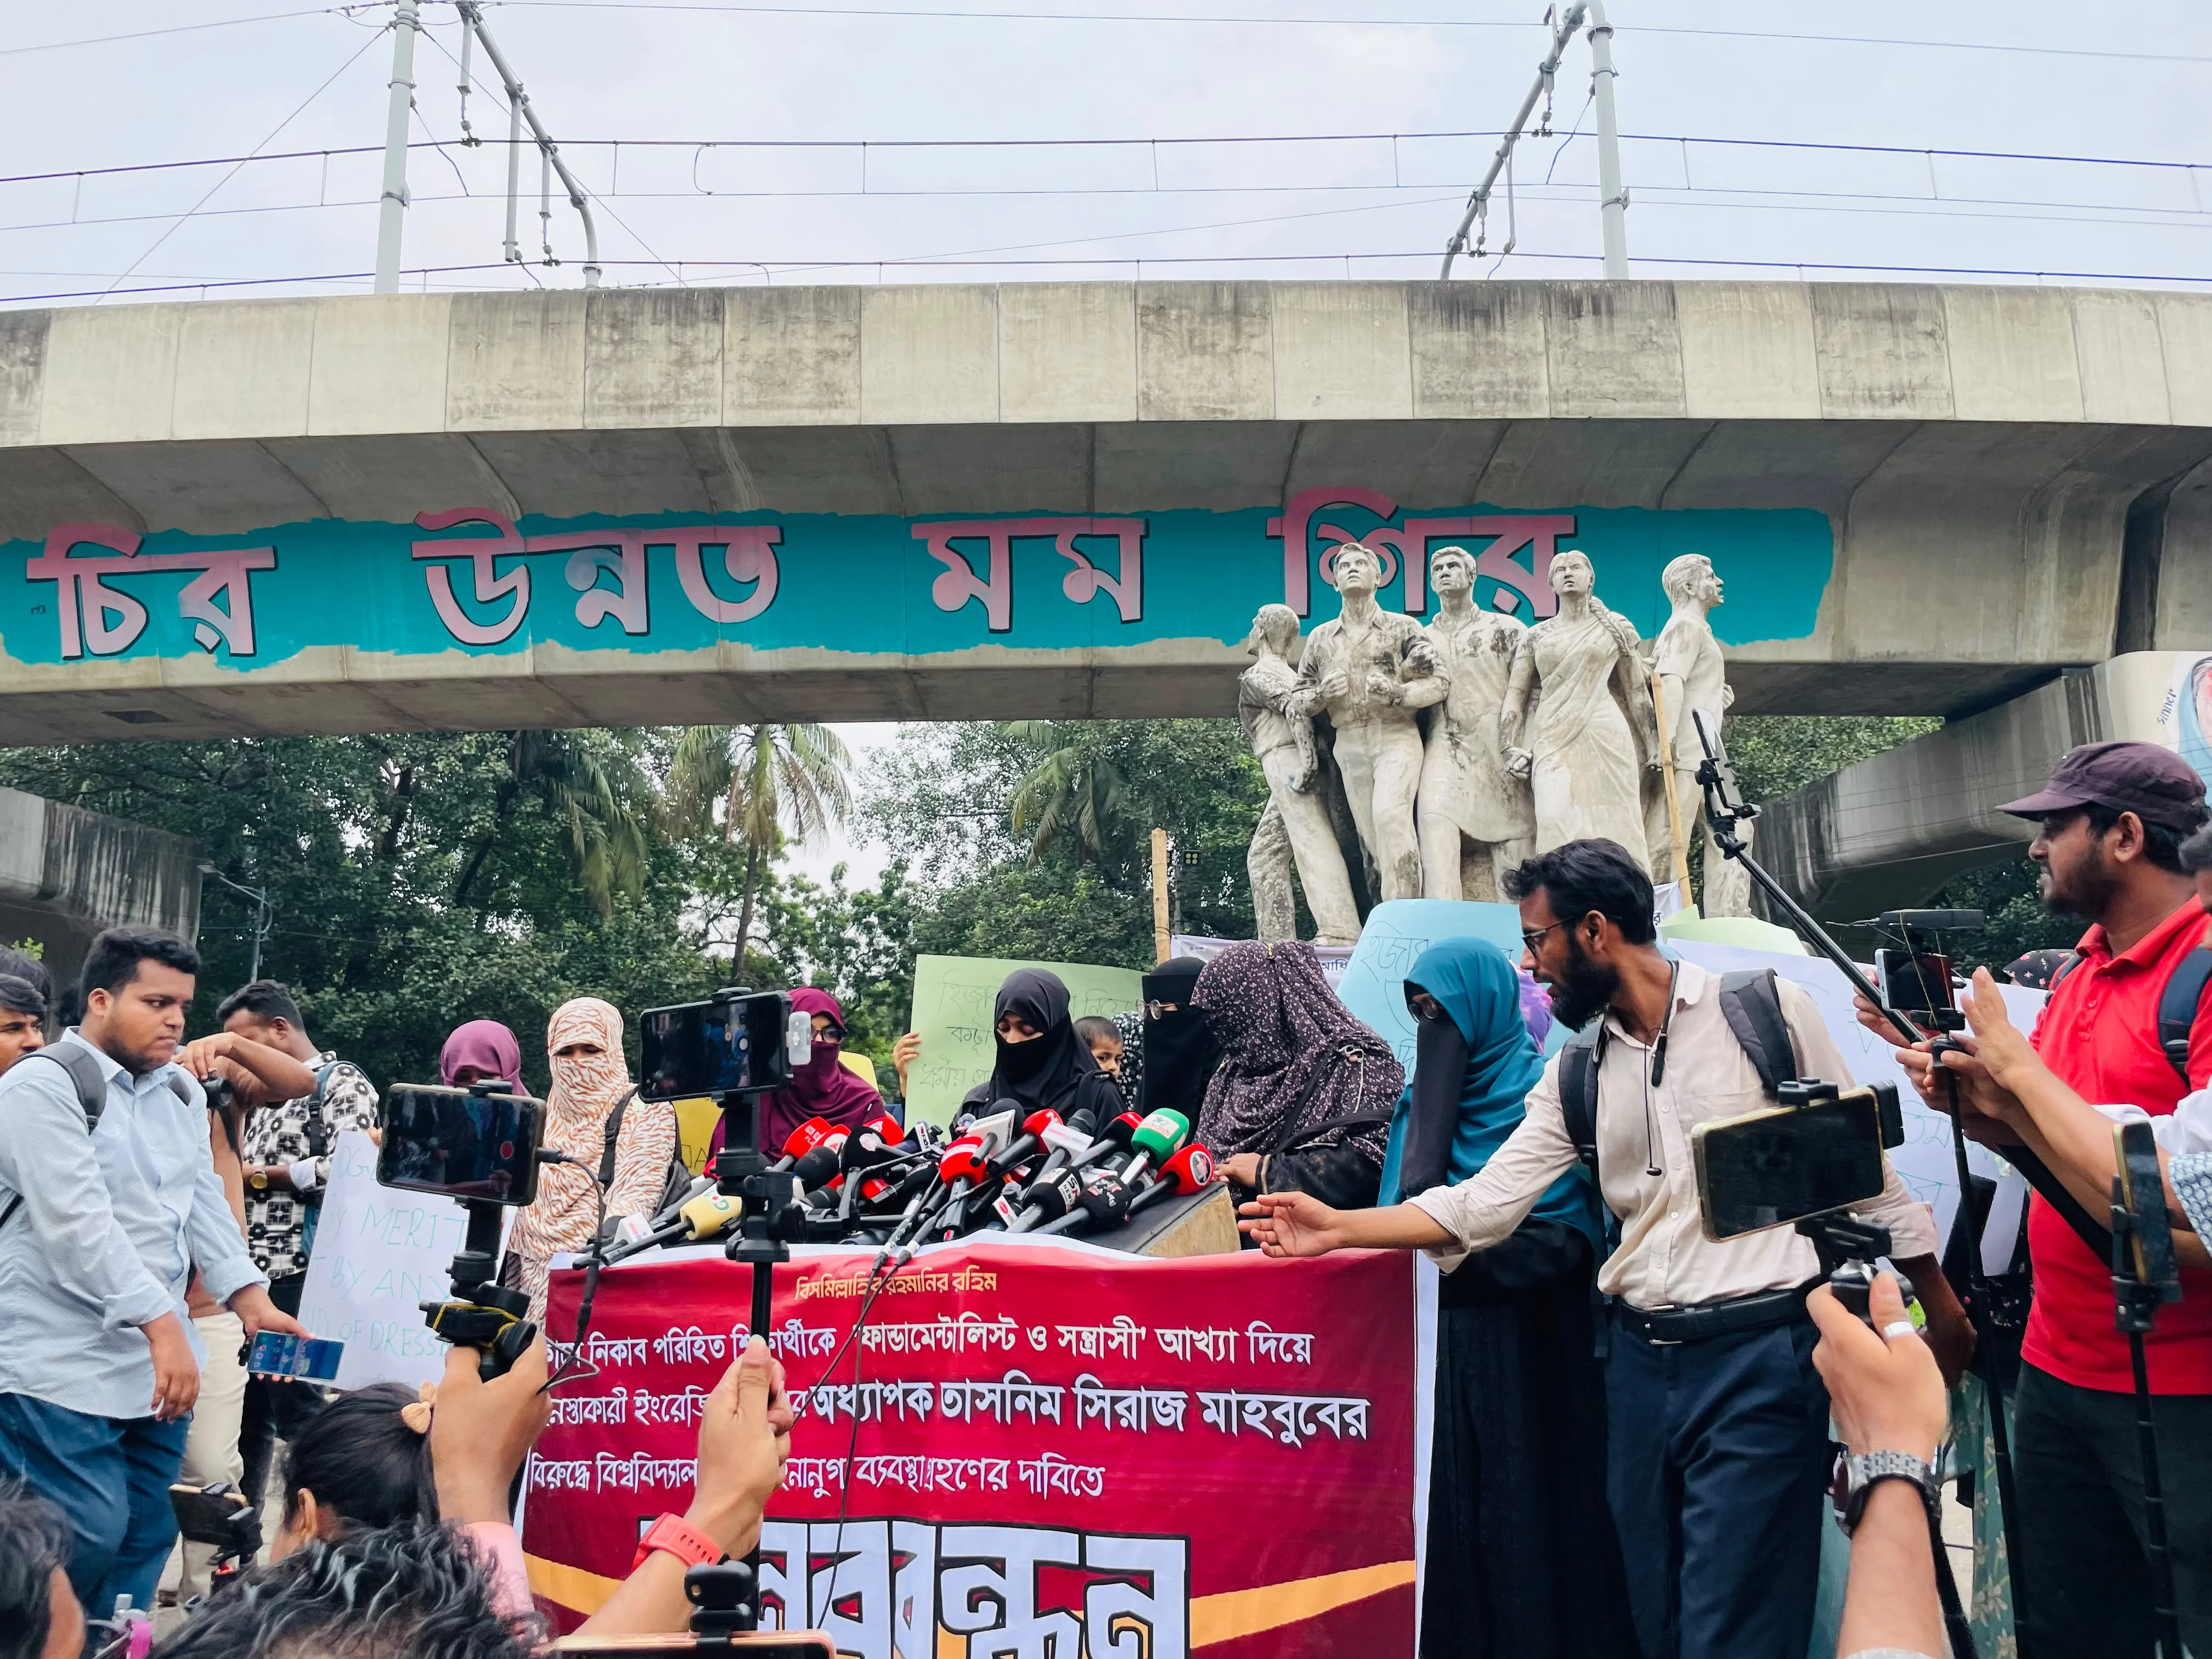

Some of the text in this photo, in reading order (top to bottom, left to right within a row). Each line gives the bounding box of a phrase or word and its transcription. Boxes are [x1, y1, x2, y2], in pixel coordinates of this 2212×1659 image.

[26, 486, 1578, 660] চির উন্নত মম শির
[360, 1204, 468, 1254] MERIT
[330, 1256, 366, 1300] BY
[885, 1267, 949, 1295] রহমানির
[952, 1265, 997, 1293] রহিম
[338, 1319, 364, 1342] OF
[587, 1331, 648, 1367] নিকাব
[653, 1325, 727, 1365] পরিহিত
[1026, 1325, 1047, 1352] ও
[1153, 1324, 1240, 1364] আখ্যা
[1244, 1321, 1315, 1365] দিয়ে
[809, 1378, 935, 1425] অধ্যাপক
[940, 1369, 1066, 1425] তাসনিম
[1071, 1373, 1188, 1434] সিরাজ
[1195, 1388, 1372, 1449] মাহবুবের
[529, 1451, 593, 1494] বিরুদ্ধে
[595, 1451, 698, 1495] বিশ্ববিদ্যাল
[1017, 1452, 1106, 1500] দাবিতে
